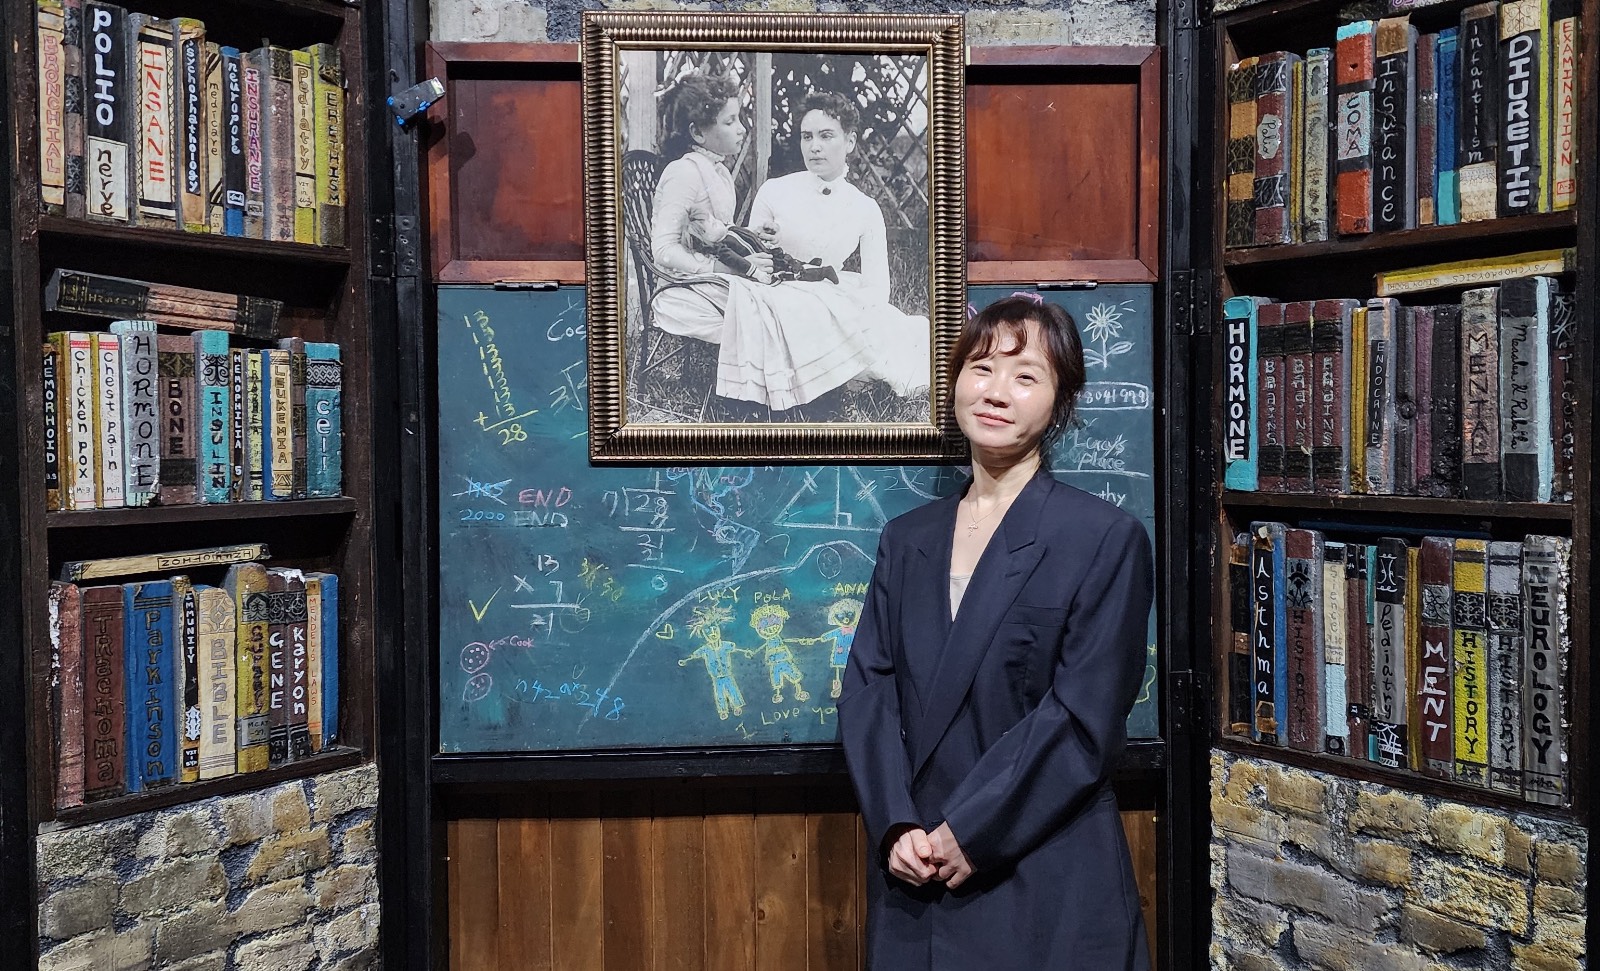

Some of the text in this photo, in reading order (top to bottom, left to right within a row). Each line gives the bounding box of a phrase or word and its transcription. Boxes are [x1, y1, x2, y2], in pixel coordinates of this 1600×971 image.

[43, 34, 60, 174] BRONCHIAL
[144, 48, 166, 183] INSANE
[209, 82, 219, 156] medicare
[227, 62, 241, 155] neuropore
[245, 68, 262, 193] INSURANCE
[1346, 95, 1362, 155] COMA
[1380, 58, 1398, 223] Insurance
[1467, 21, 1484, 163] infantilism
[1506, 35, 1533, 208] DIURETIC
[1562, 21, 1573, 166] EXAMINATION
[97, 148, 115, 217] nerve
[43, 355, 56, 464] HEMORHOID
[168, 380, 184, 456] BONE
[209, 391, 226, 489] INSULIN
[233, 353, 243, 449] HEMOPHILIA
[274, 365, 288, 464] LEUKEMIA
[497, 423, 528, 446] 28
[1228, 322, 1246, 459] HORMONE
[1371, 341, 1385, 444] ENDOCRINE
[106, 421, 117, 471] pain
[459, 508, 506, 521] 2000
[513, 510, 569, 527] END
[518, 486, 572, 508] END
[185, 592, 195, 664] IMMUNITY
[268, 632, 285, 709] GENE
[291, 626, 306, 715] Karyon
[1256, 556, 1271, 695] Asthma
[1293, 610, 1306, 723] HISTORY
[1528, 565, 1555, 765] NEUROLOGY
[210, 639, 229, 744] BIBLE
[310, 670, 318, 706] LAWS
[1423, 640, 1448, 742] MENT
[1461, 631, 1479, 755] HISTORY
[1500, 635, 1514, 763] HISTORY
